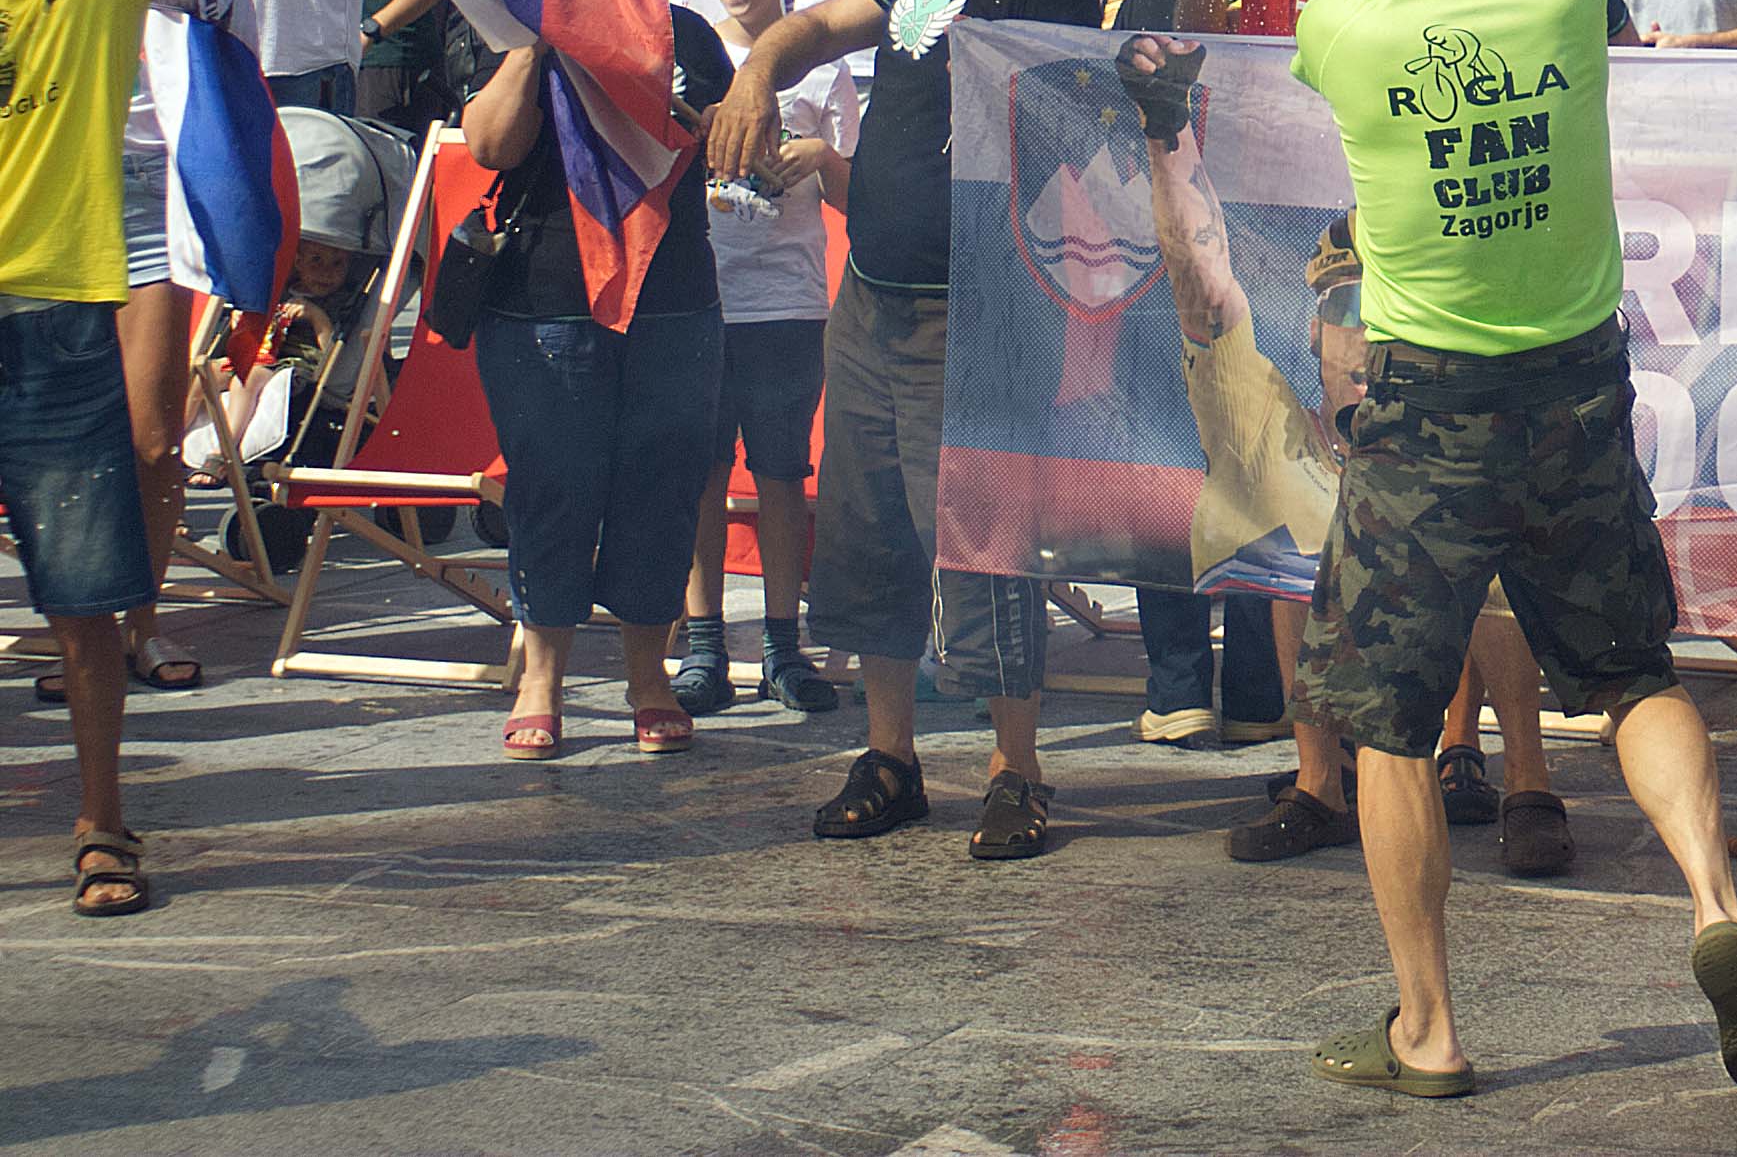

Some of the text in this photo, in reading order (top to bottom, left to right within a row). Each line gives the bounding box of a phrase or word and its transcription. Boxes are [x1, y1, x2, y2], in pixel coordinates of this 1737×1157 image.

[1424, 111, 1551, 170] FAN
[1432, 163, 1552, 210] CLUB
[1439, 201, 1550, 240] Zagorje
